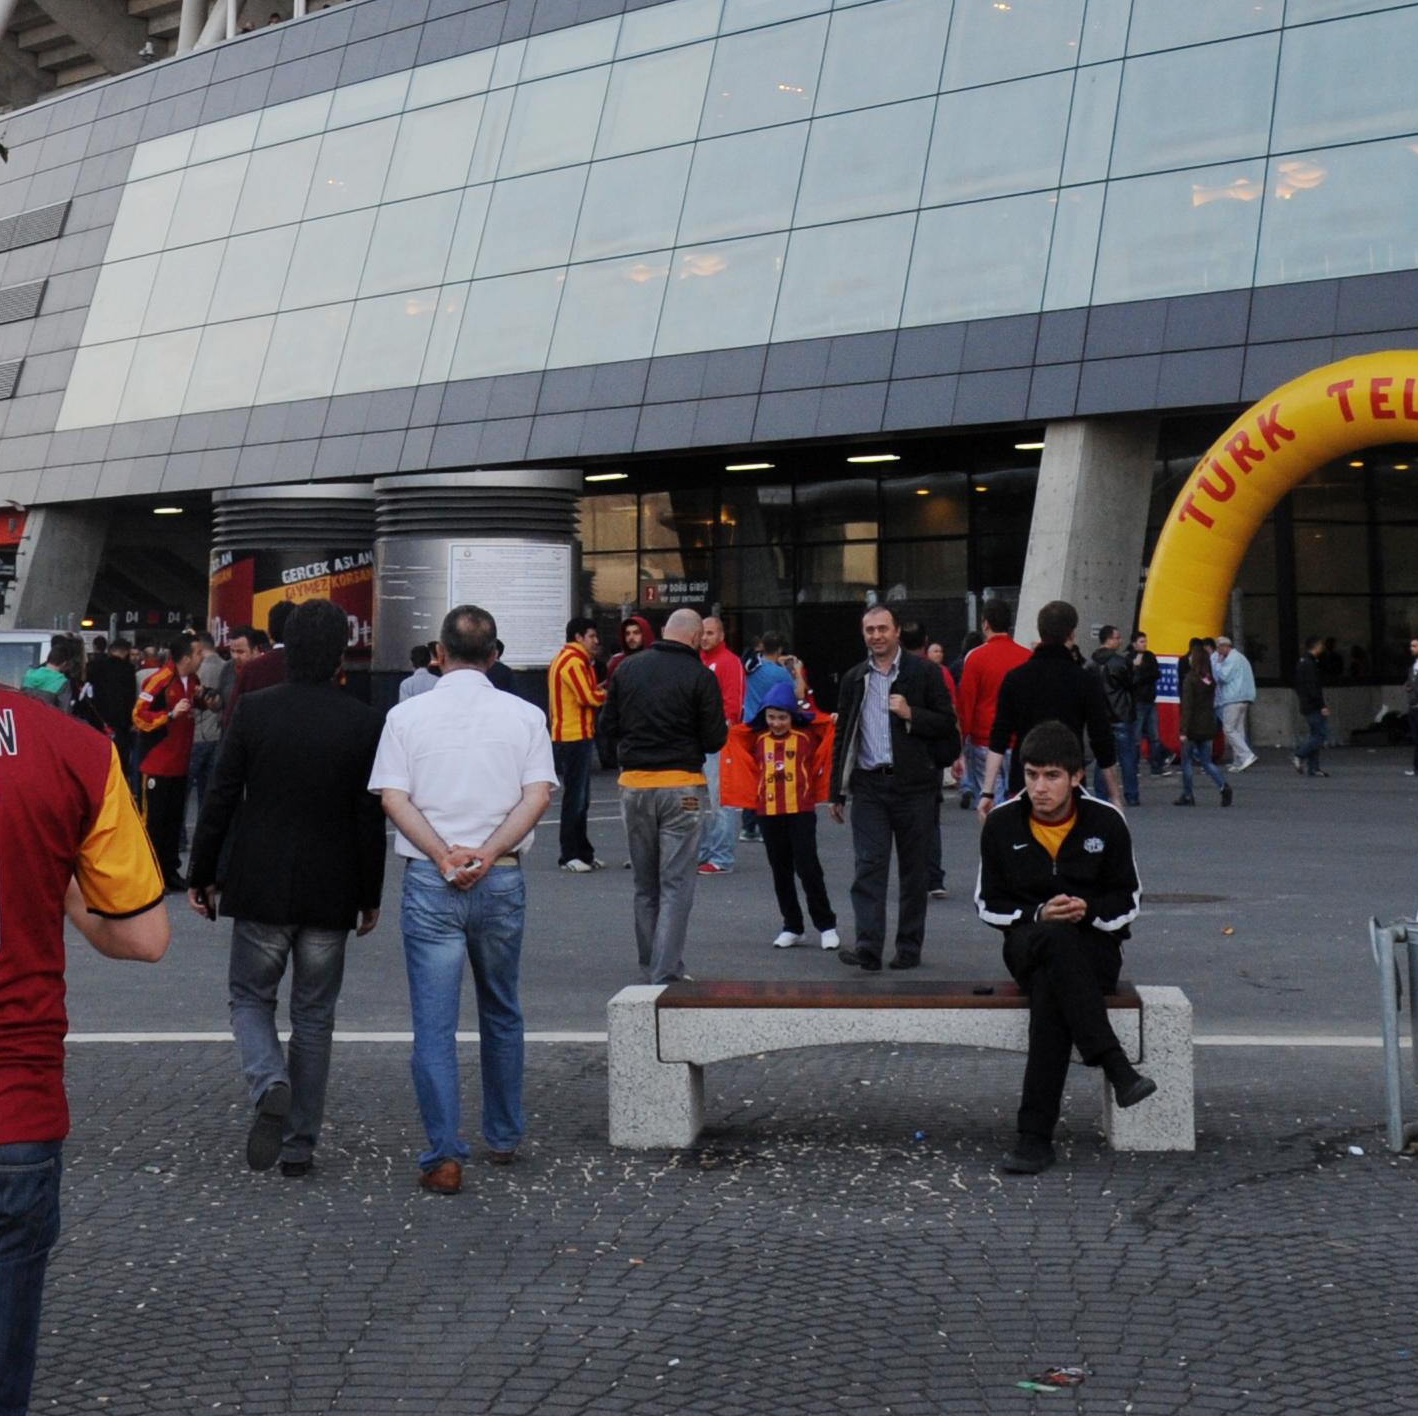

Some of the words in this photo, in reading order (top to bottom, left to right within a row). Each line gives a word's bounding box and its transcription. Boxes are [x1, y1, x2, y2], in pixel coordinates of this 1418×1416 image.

[1178, 403, 1296, 530] TÜRK
[334, 550, 373, 572] ASLAN
[647, 587, 654, 600] 2
[125, 610, 139, 623] D4
[167, 611, 181, 624] D4
